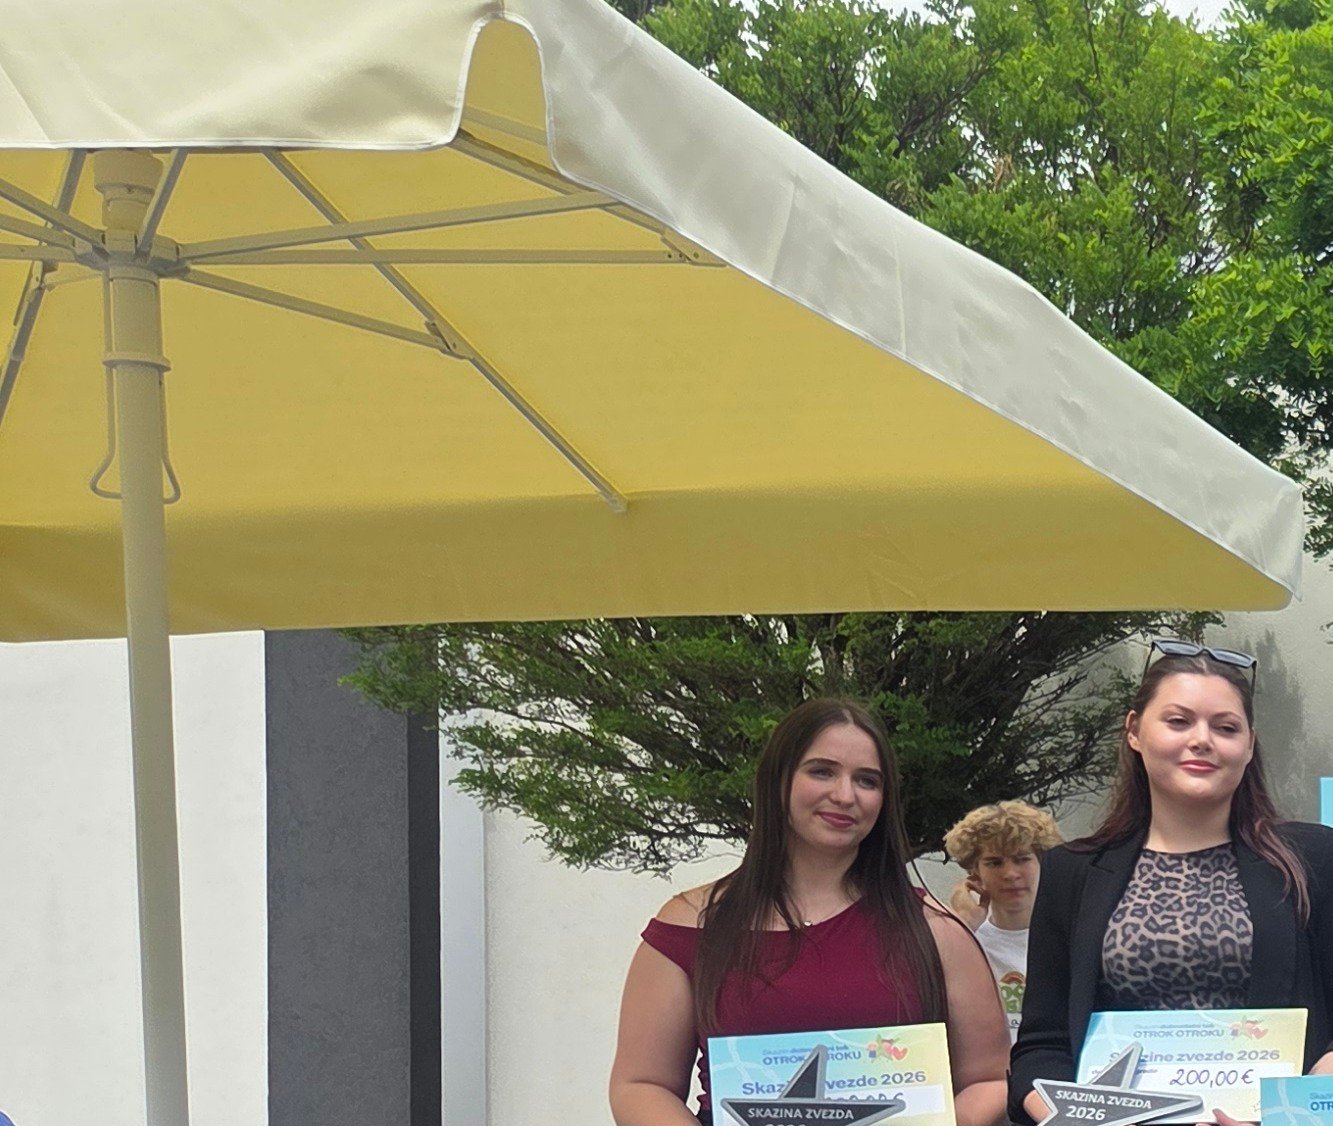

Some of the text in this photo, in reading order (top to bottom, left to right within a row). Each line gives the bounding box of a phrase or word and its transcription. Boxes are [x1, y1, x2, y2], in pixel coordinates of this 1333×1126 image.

[1133, 1029, 1224, 1039] OTROK OTROKU
[827, 1051, 861, 1061] ROKU
[1109, 1050, 1280, 1063] Szine zvezde 2026
[742, 1071, 926, 1095] Skaz vezde 2026
[1055, 1090, 1152, 1109] SKAZINA ZVEZDA
[748, 1108, 854, 1120] SKAZINA ZVEZDA
[1066, 1105, 1106, 1120] 2026
